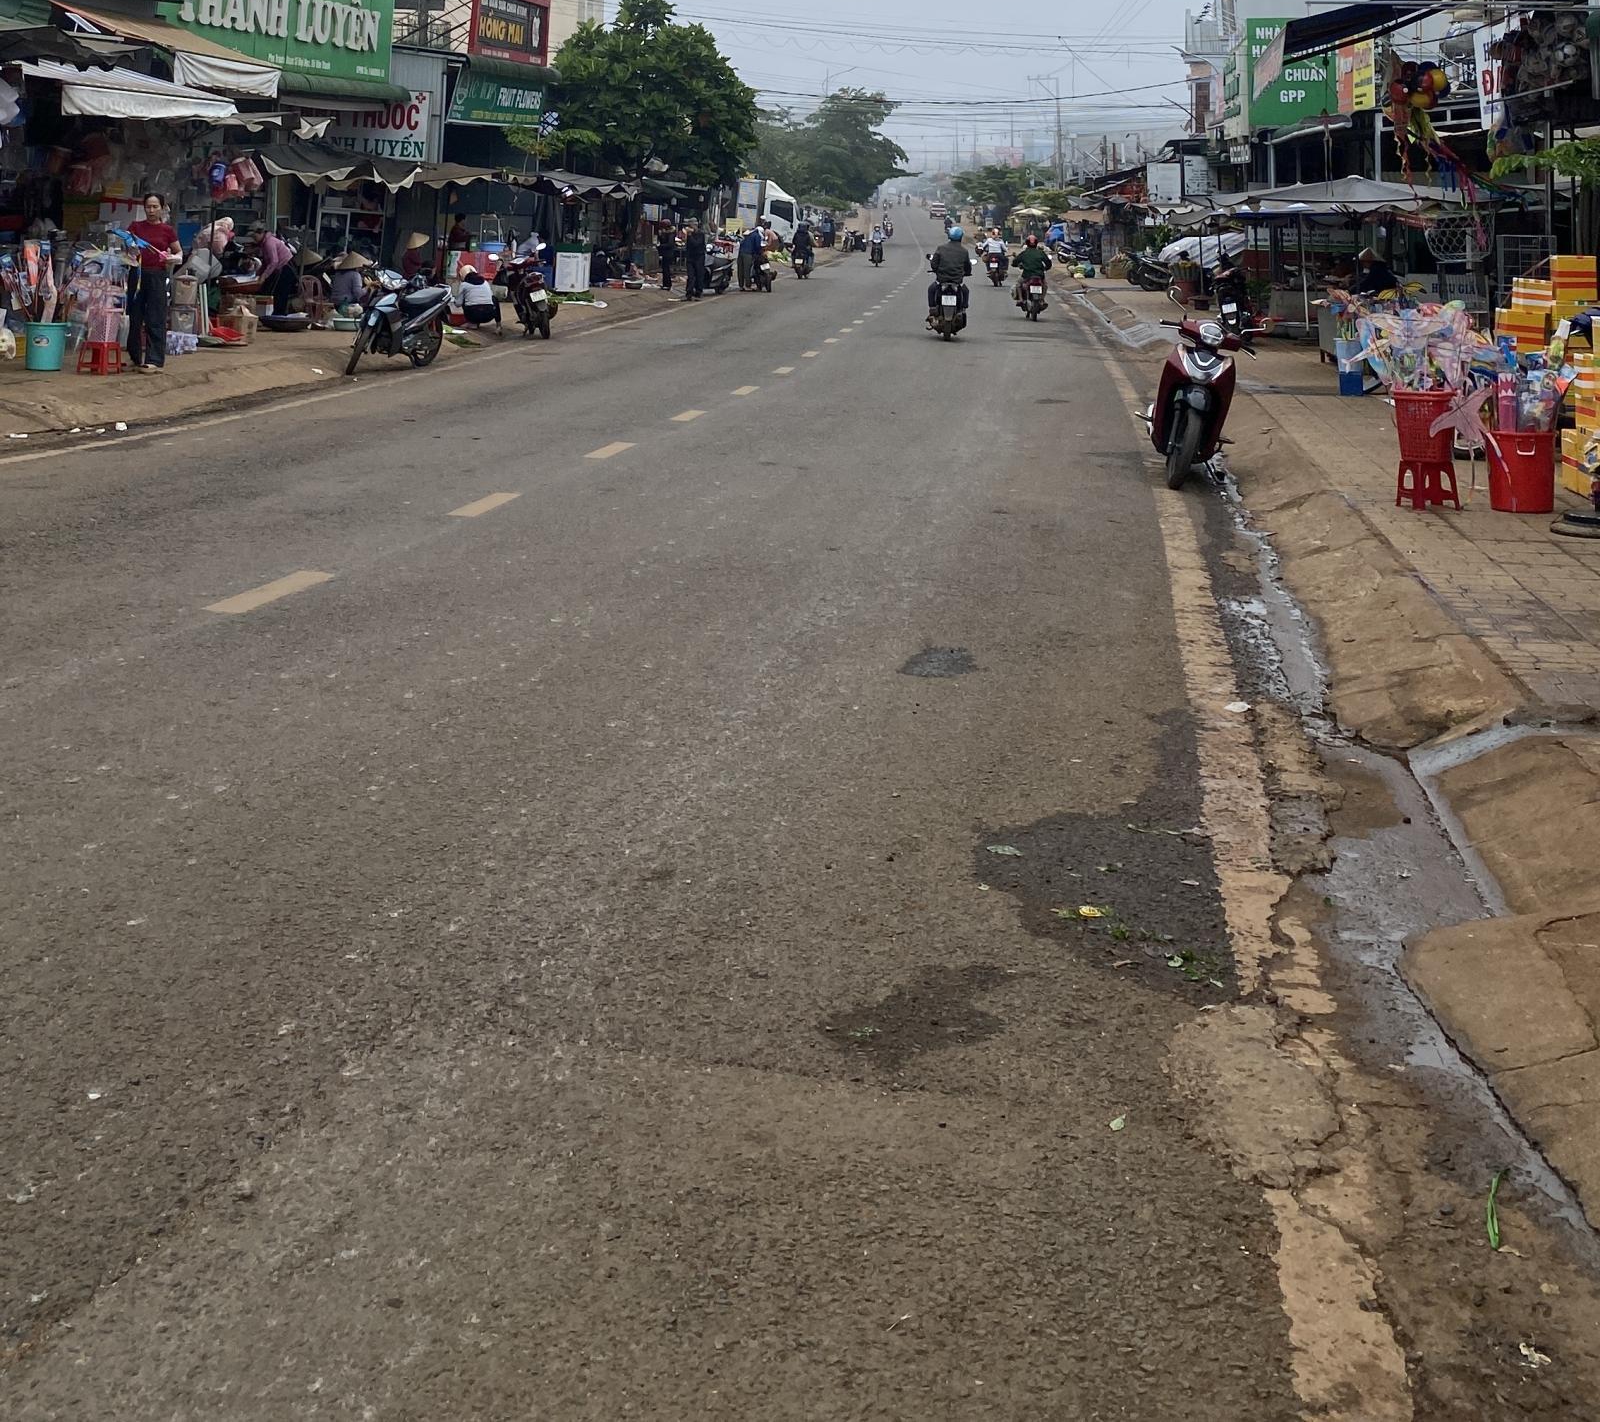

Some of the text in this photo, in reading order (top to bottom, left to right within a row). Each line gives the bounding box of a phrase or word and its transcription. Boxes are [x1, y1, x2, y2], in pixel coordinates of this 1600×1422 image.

[479, 9, 524, 45] HỒNG MAI
[497, 86, 517, 108] FRUIT
[515, 89, 543, 110] FLOWERS
[1279, 89, 1306, 103] GPP
[363, 133, 425, 158] LUYẾN
